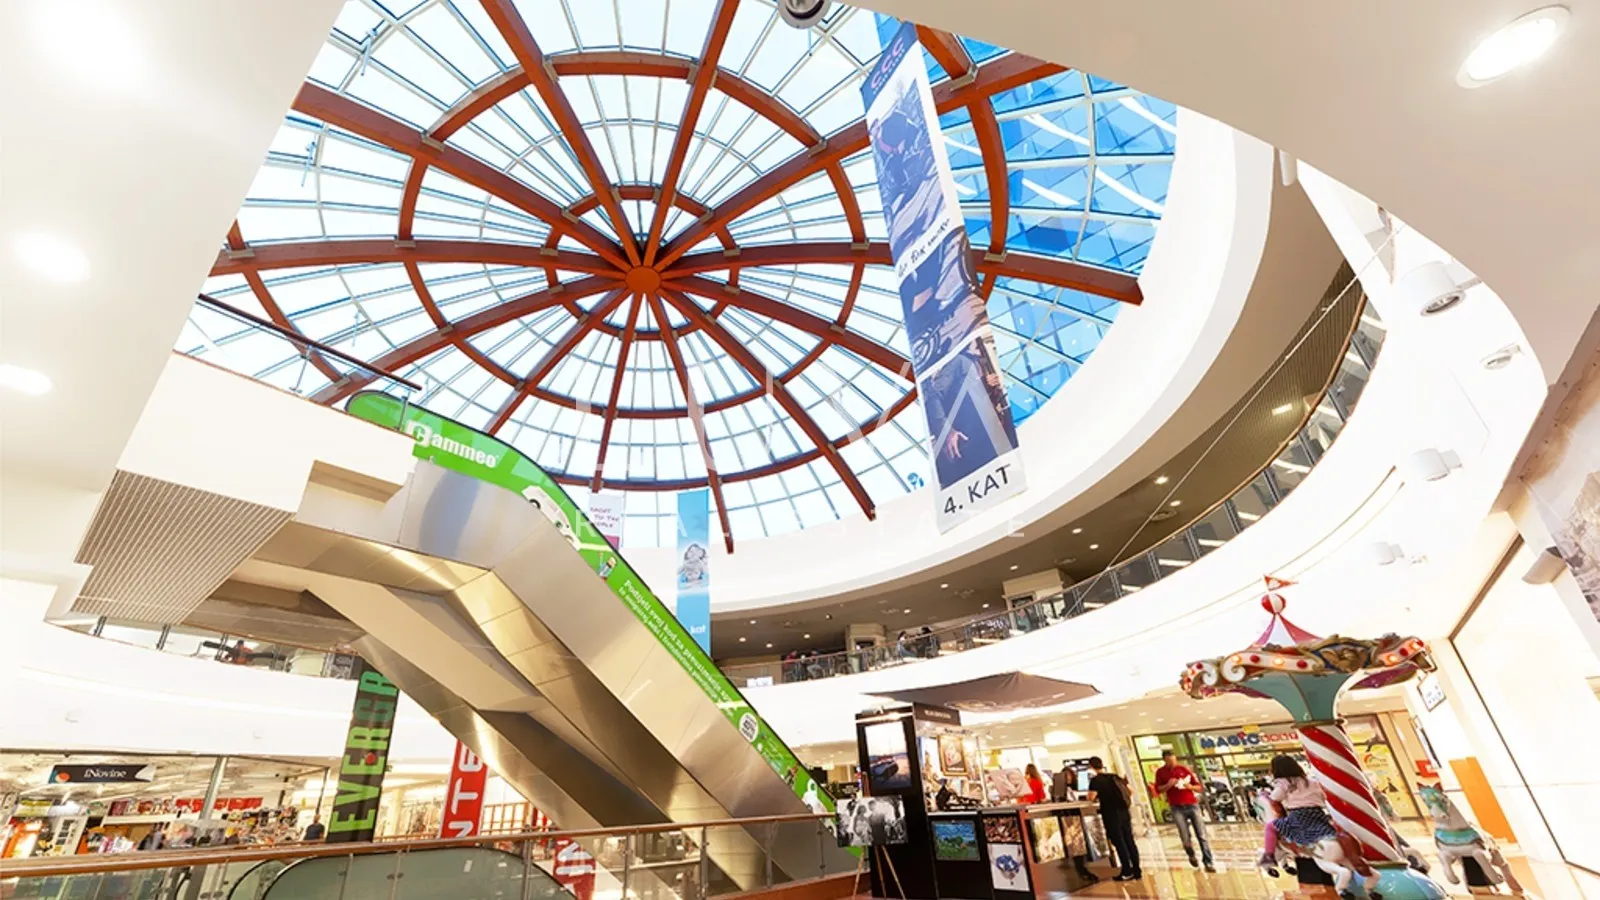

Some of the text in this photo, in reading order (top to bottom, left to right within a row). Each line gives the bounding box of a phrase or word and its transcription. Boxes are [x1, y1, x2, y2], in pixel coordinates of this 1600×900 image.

[944, 463, 1011, 514] 4. KAT
[1200, 732, 1261, 749] MAGIC
